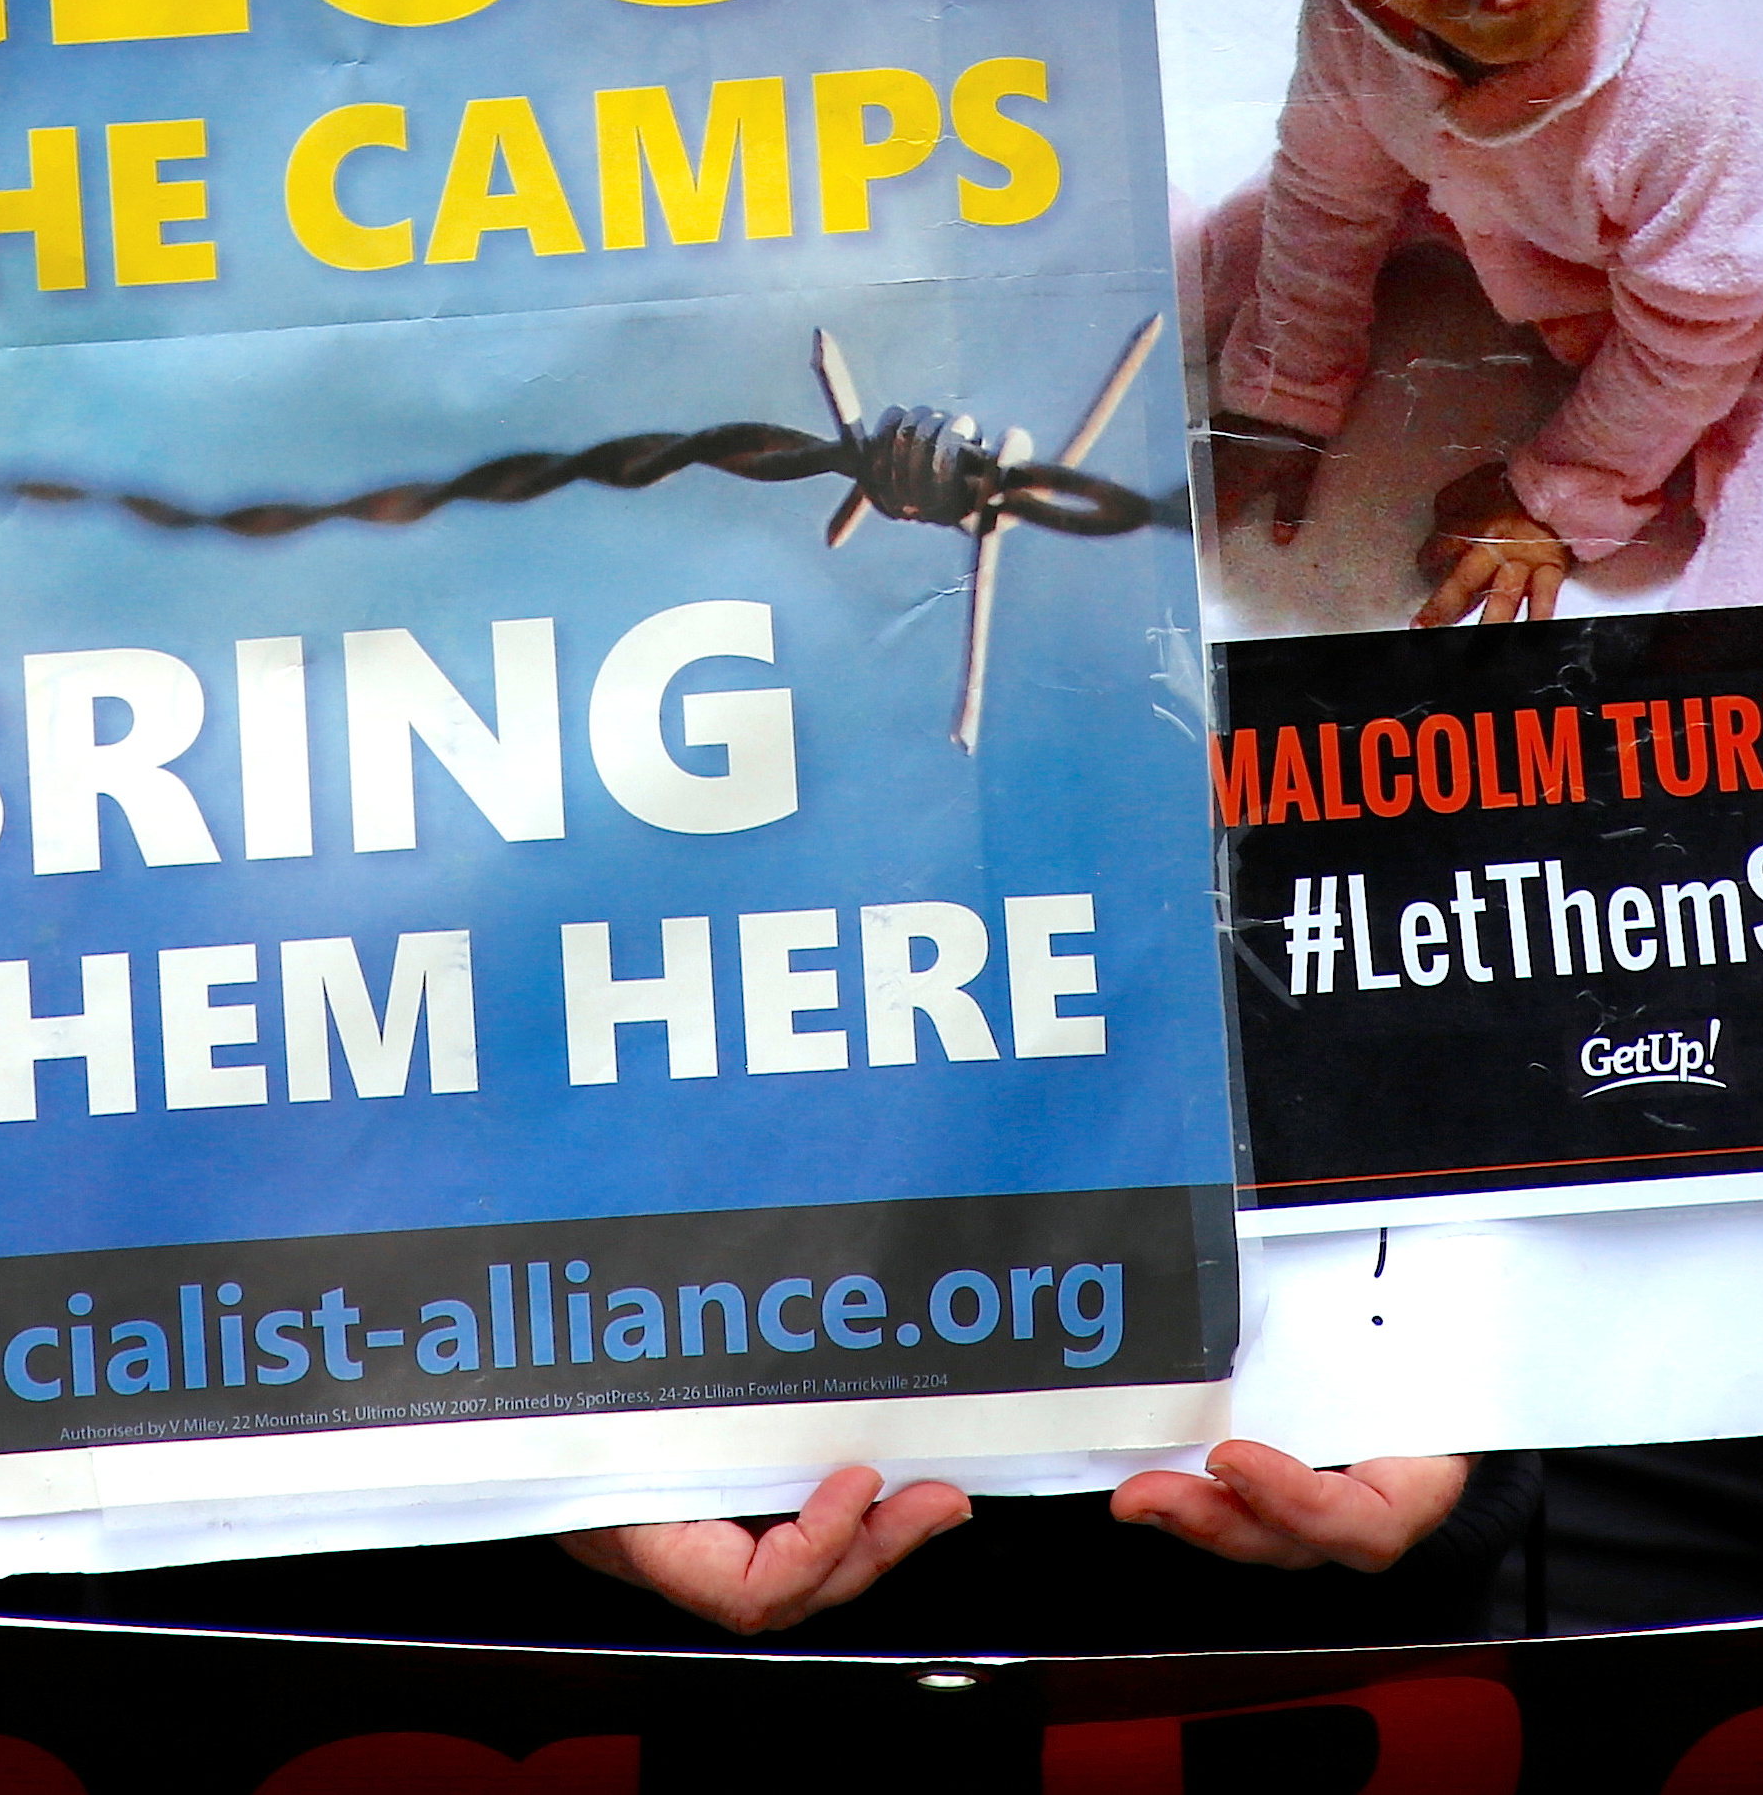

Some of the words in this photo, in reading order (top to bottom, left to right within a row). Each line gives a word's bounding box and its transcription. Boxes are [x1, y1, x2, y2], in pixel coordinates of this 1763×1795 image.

[285, 57, 1062, 272] CAMPS
[1209, 706, 1586, 828] MALCOLM
[561, 894, 1107, 1087] HERE
[1581, 1018, 1721, 1082] GetUp!
[60, 1421, 144, 1442] Authorised
[147, 1420, 167, 1438] by
[169, 1419, 180, 1434] V
[183, 1415, 229, 1435] Miley,
[232, 1415, 251, 1430] 22
[254, 1409, 329, 1428] Mountain
[332, 1408, 352, 1425] St,
[354, 1404, 406, 1422] Ultimo
[409, 1401, 446, 1419] NSW
[450, 1398, 492, 1415] 2007.
[495, 1393, 552, 1413] Printed
[555, 1393, 573, 1411] by
[576, 1387, 654, 1410] SpotPress,
[658, 1385, 701, 1402] 24-26
[704, 1382, 745, 1400] Lilian
[748, 1379, 801, 1397] Fowler
[824, 1374, 909, 1393] Marrickville
[912, 1373, 948, 1389] 2204
